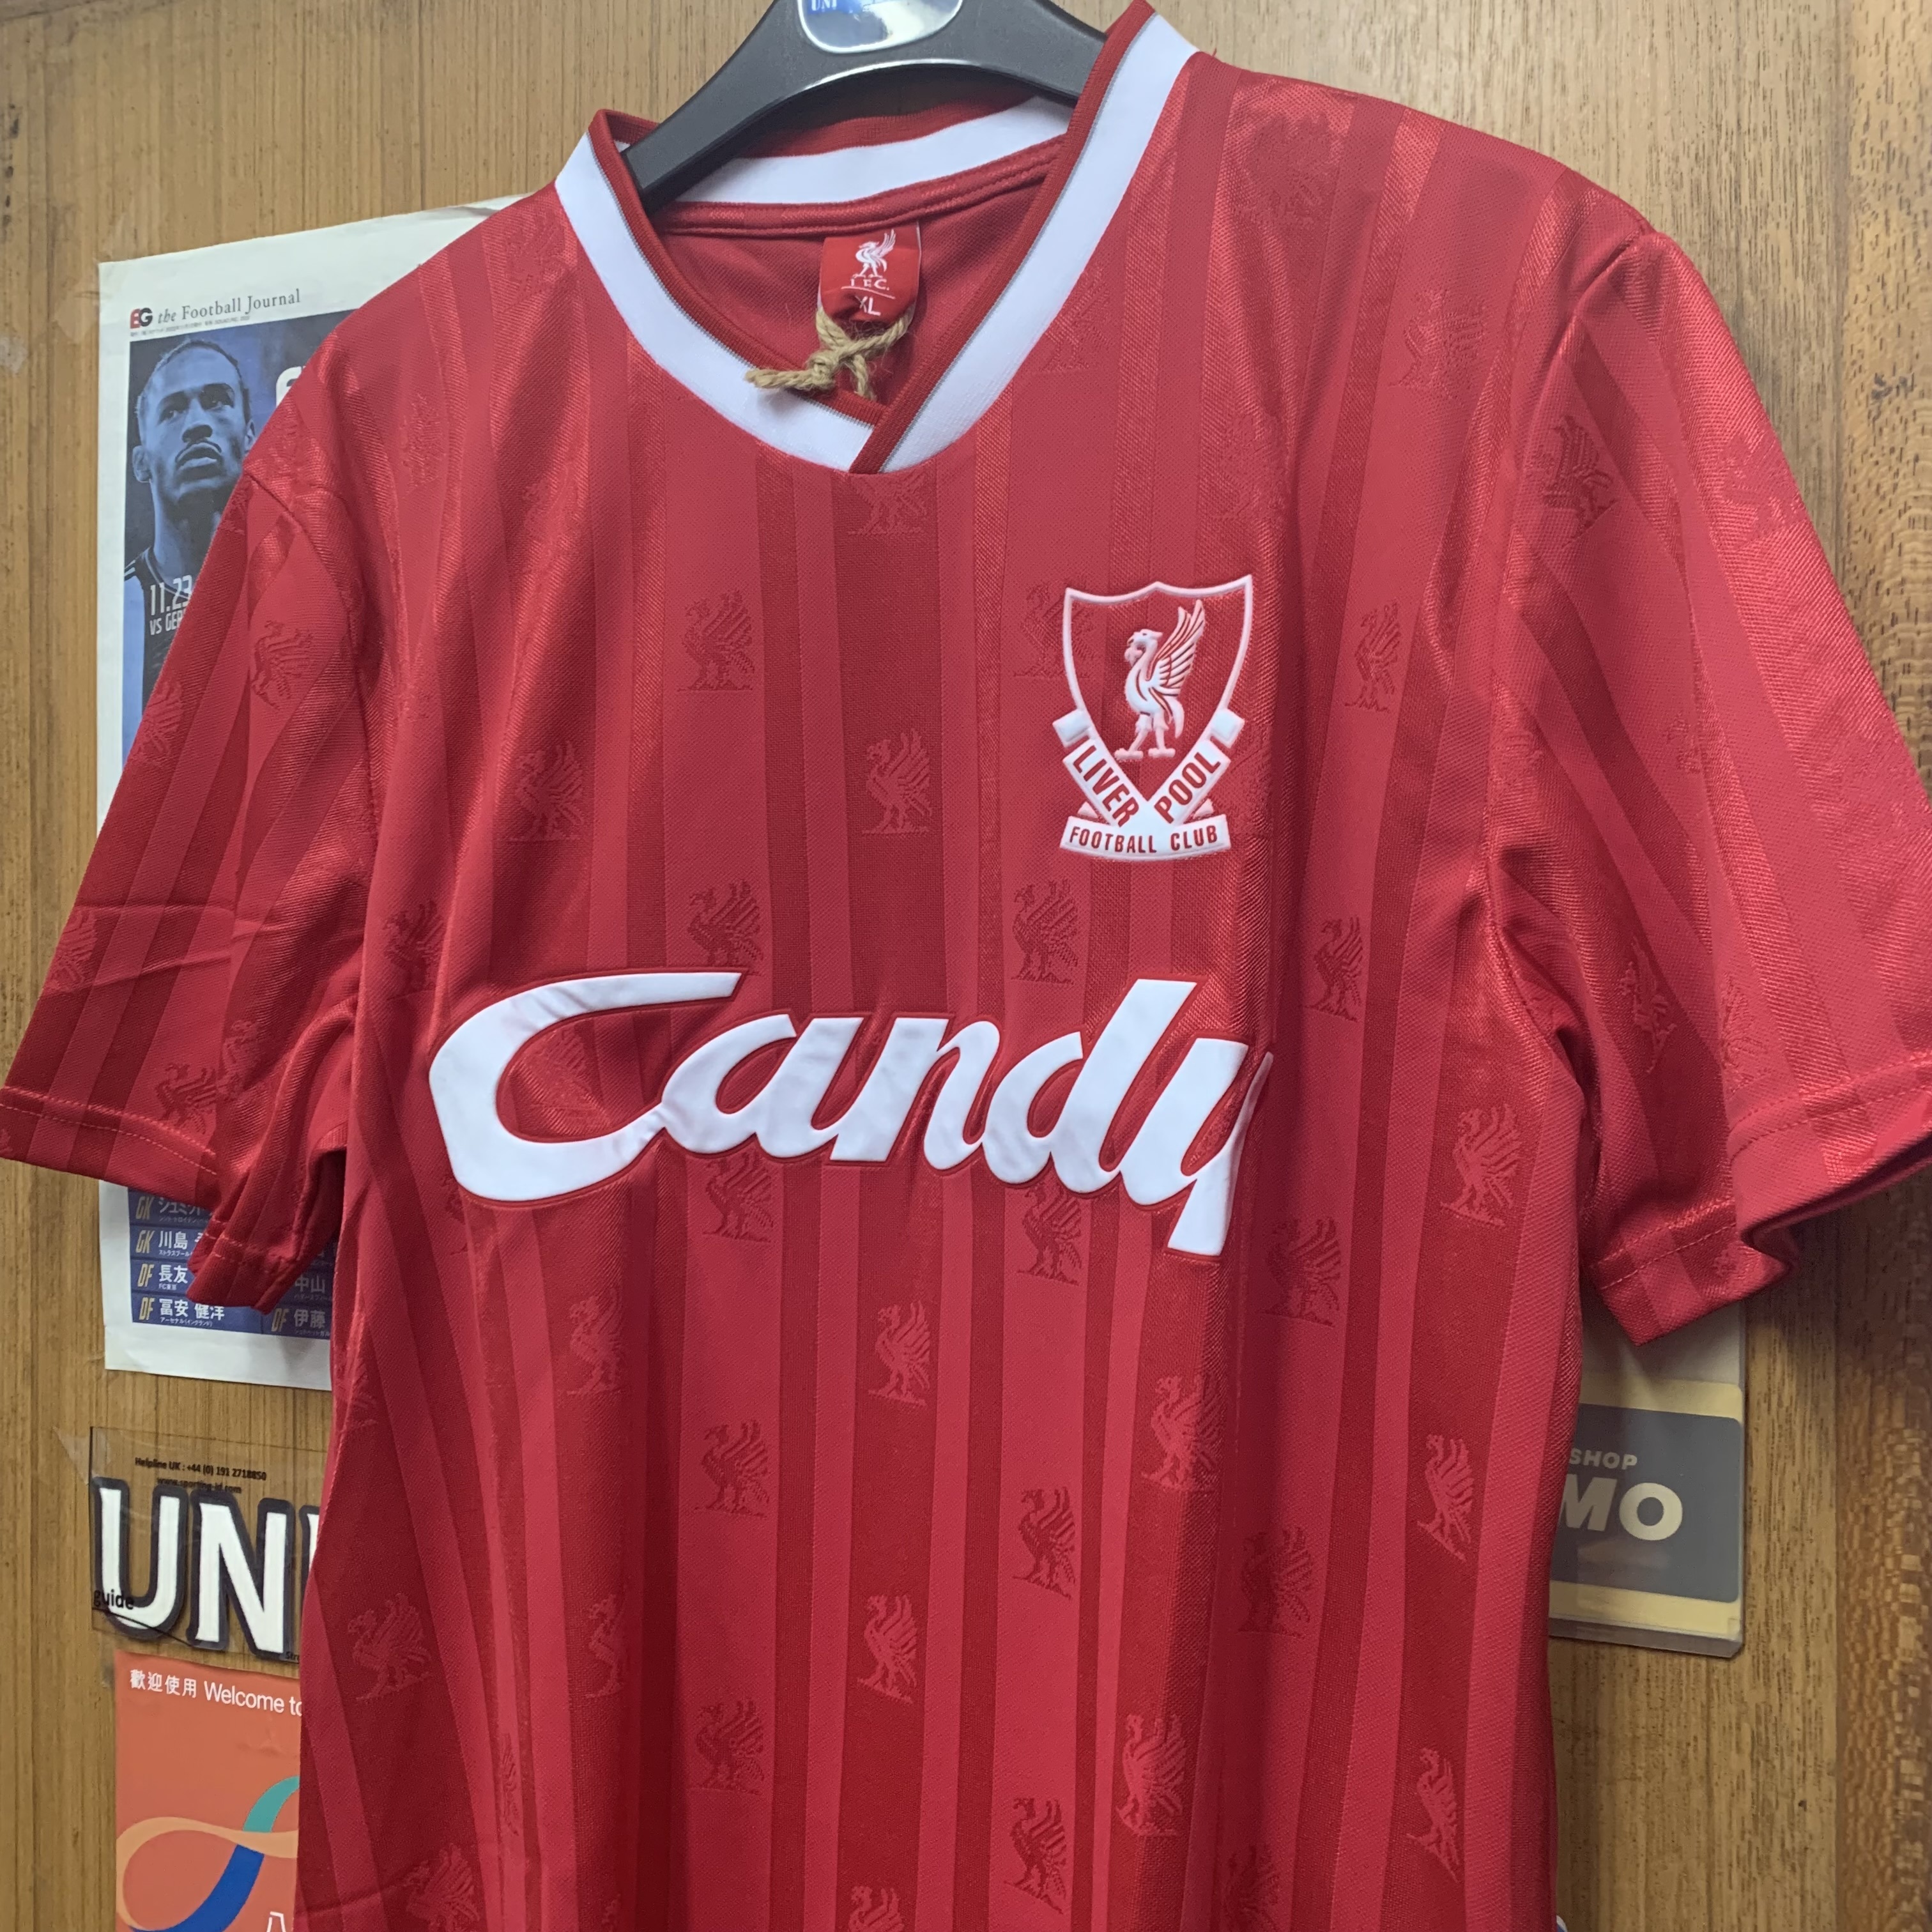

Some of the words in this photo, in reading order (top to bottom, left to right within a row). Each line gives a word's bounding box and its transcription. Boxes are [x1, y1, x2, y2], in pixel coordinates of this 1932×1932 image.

[158, 309, 176, 324] the
[181, 297, 241, 319] Football
[245, 288, 300, 314] Journal
[855, 295, 881, 316] XL
[150, 574, 193, 616] 11.23
[150, 617, 162, 636] VS
[1072, 744, 1139, 827] LIVER
[1154, 751, 1222, 824] POOL
[1068, 826, 1157, 854] FOOTBALL
[1170, 825, 1218, 851] CLUB
[429, 971, 1274, 1254] Candy
[135, 1196, 155, 1220] GK
[135, 1230, 155, 1254] GK
[158, 1230, 188, 1250] 川島
[137, 1263, 155, 1287] DF
[158, 1264, 188, 1284] 長友
[295, 1274, 326, 1294] 中山
[139, 1297, 156, 1321] DF
[272, 1308, 289, 1333] DF
[293, 1308, 326, 1329] 伊藤
[135, 1457, 167, 1469] Helpline
[169, 1460, 181, 1471] UK
[187, 1463, 201, 1473] +44
[203, 1465, 214, 1476] (0)
[216, 1466, 230, 1476] 191
[1569, 1448, 1638, 1470] SHOP
[1559, 1473, 1683, 1541] MO
[93, 1589, 135, 1609] guide
[130, 1669, 197, 1699] 歡迎使用
[204, 1680, 285, 1713] Welcome
